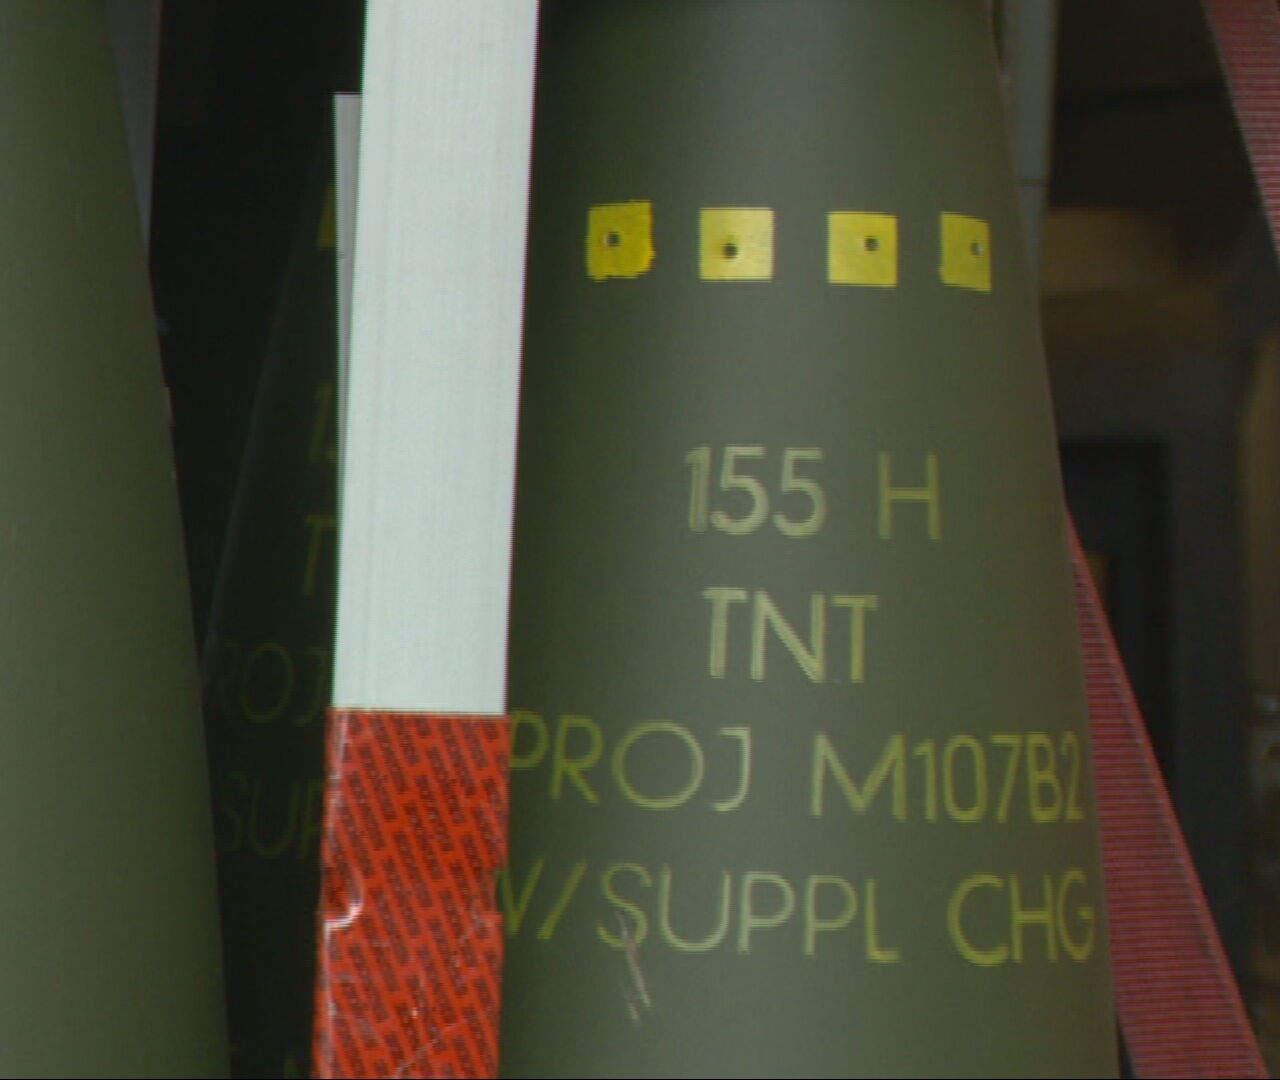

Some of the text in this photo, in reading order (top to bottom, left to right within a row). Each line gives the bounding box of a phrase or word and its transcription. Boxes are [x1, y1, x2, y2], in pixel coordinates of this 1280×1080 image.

[685, 443, 941, 541] 155 H
[700, 586, 881, 685] TNT
[507, 709, 1088, 824] PROJ M107B2
[946, 870, 1097, 969] CHG
